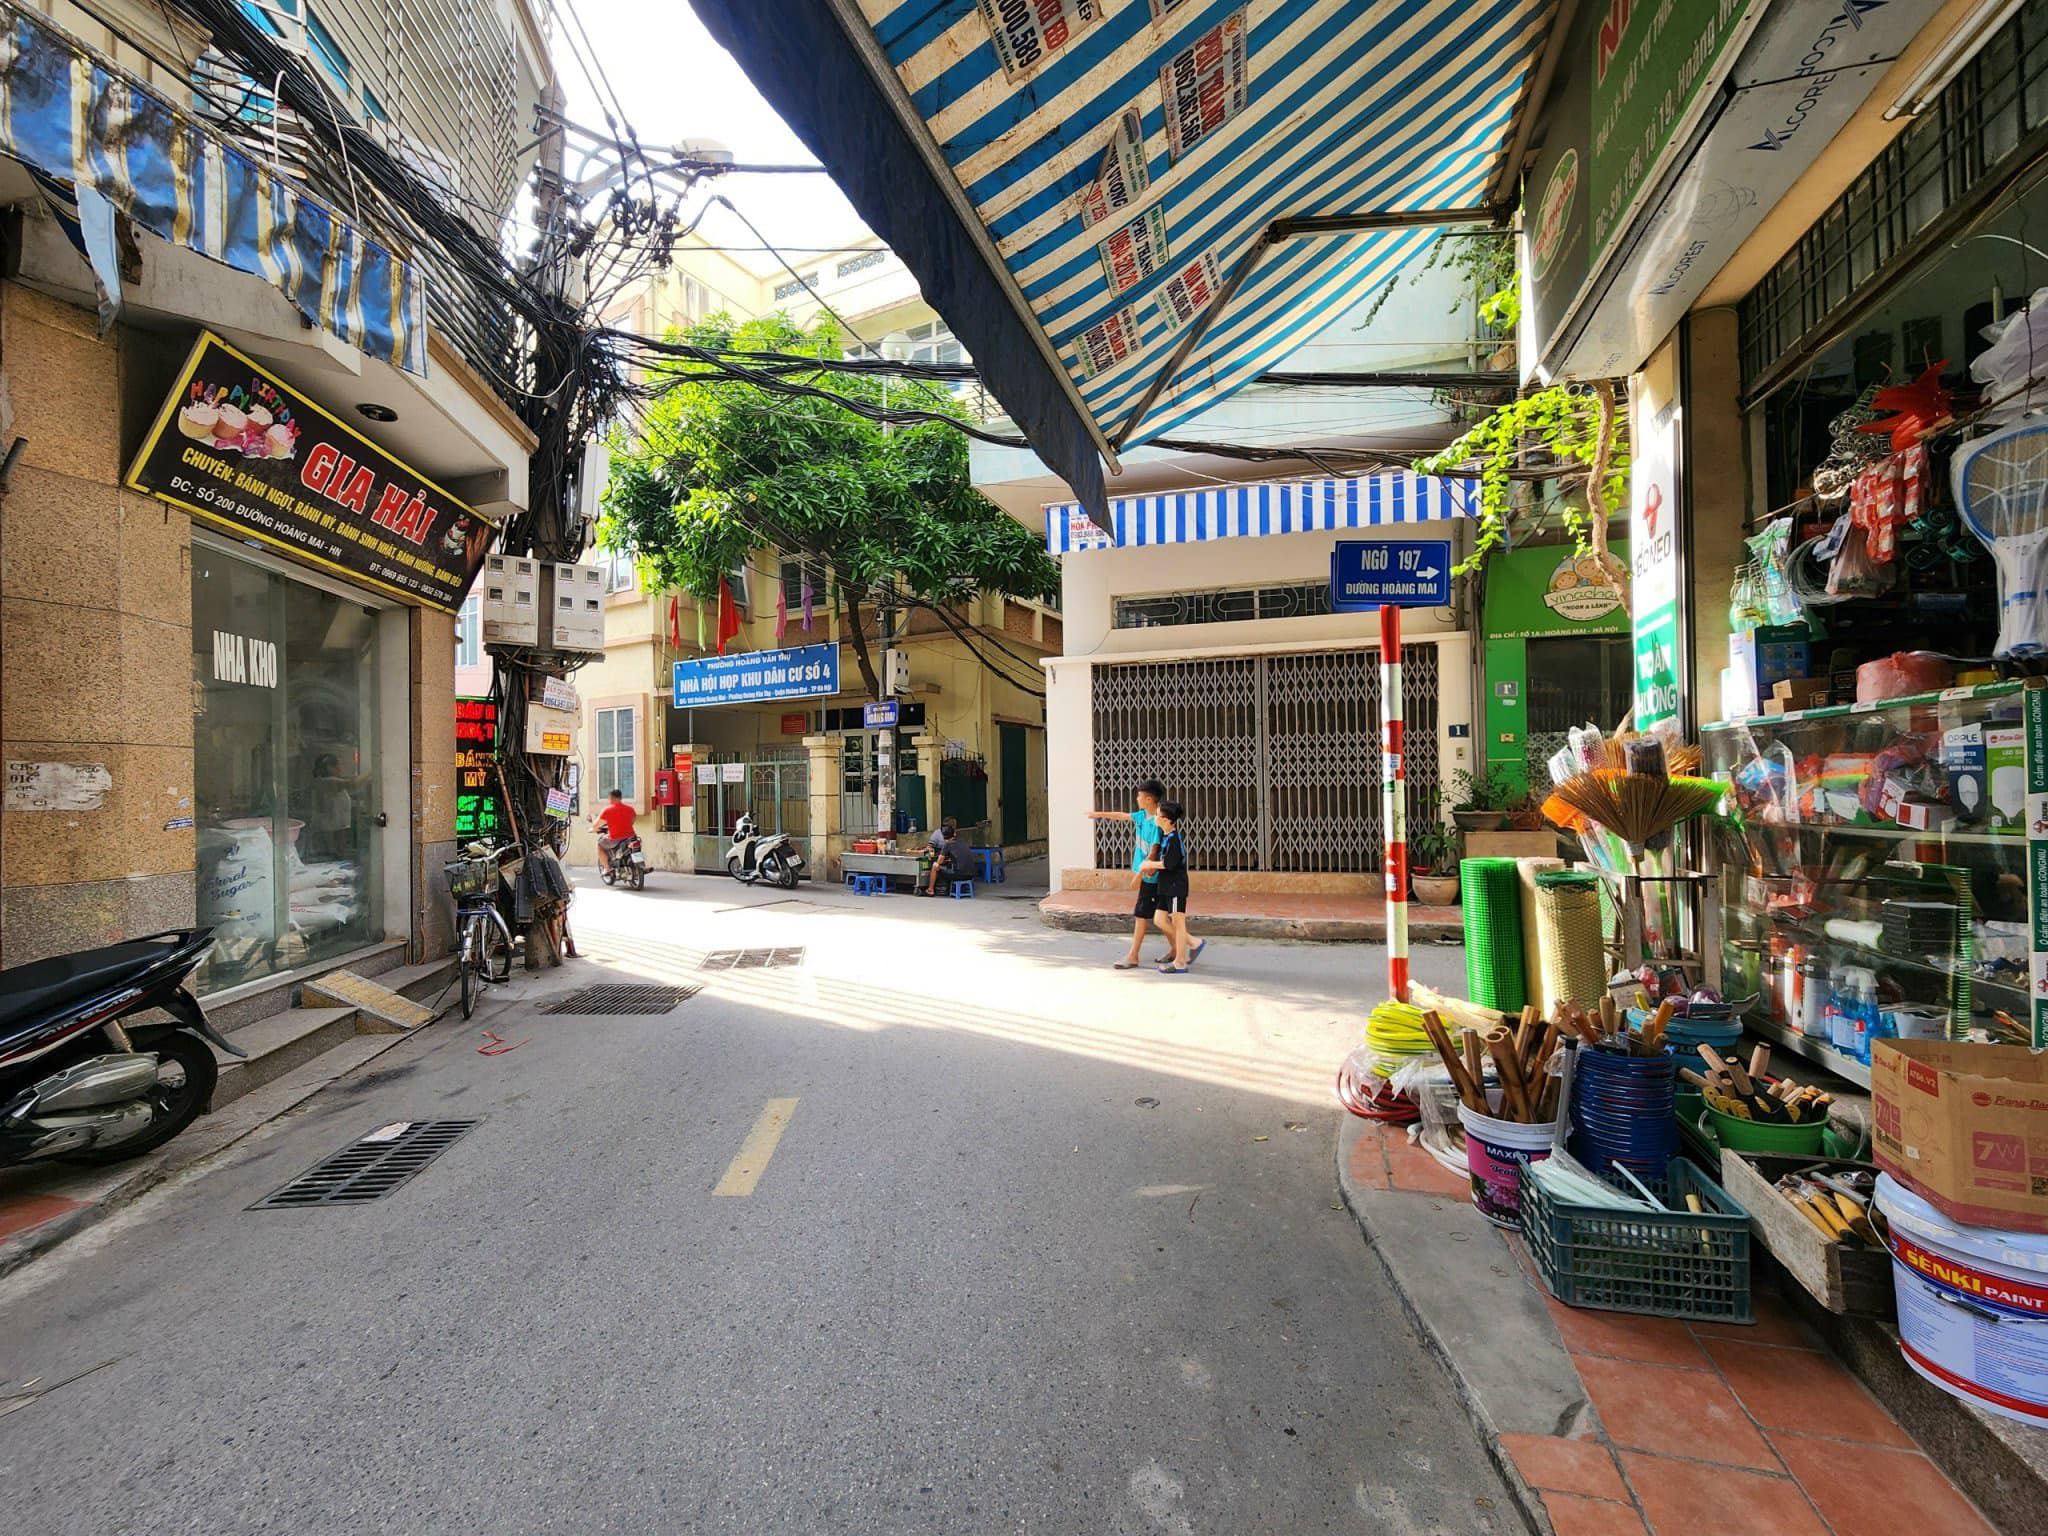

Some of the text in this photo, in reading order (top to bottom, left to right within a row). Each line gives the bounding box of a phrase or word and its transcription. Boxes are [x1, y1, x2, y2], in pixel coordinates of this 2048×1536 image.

[1678, 16, 1715, 103] Hoàng
[1170, 46, 1205, 150] 0962.363.568
[1195, 60, 1234, 136] THÀNH
[1130, 212, 1152, 245] PHÚ
[1135, 237, 1158, 278] THÀNH
[191, 379, 250, 409] HAPPY
[300, 442, 438, 546] GIA HẢI
[170, 476, 342, 558] ĐC: SỐ 200 ĐƯỜNG HOÀNG MAI HN
[182, 447, 235, 483] CHUYÊN:
[234, 472, 267, 498] BÁNH
[265, 487, 296, 513] NGỌT,
[294, 501, 323, 522] BÁNH
[320, 514, 337, 533] MỲ,
[336, 522, 361, 544] BÁNH
[359, 533, 379, 551] SINH
[395, 550, 416, 567] BÁNH
[435, 568, 452, 583] BÁNH
[1361, 546, 1422, 571] NGÕ 197
[369, 562, 382, 574] ĐT:
[408, 579, 418, 588] 123
[1345, 580, 1437, 595] ĐƯỜNG HOÀNG MAI
[1520, 628, 1531, 638] SỐ
[1545, 628, 1572, 636] HOÀNG
[1605, 626, 1619, 634] NỘI
[213, 630, 277, 688] NHA KHO
[735, 657, 760, 666] HOÀNG
[680, 660, 831, 693] NHÀ HỘI HỌP KHU DÂN CƯ SỐ 4
[2031, 690, 2042, 723] GONGNIU
[1947, 734, 1977, 743] OPPLE
[2033, 724, 2043, 739] toàn
[2035, 740, 2043, 748] an
[464, 768, 487, 787] MỲ
[2037, 849, 2047, 881] GONGNIU
[2038, 883, 2047, 897] toàn
[2040, 899, 2048, 907] an
[1975, 1141, 2022, 1161] 7W
[1984, 1286, 2046, 1309] PAINT
